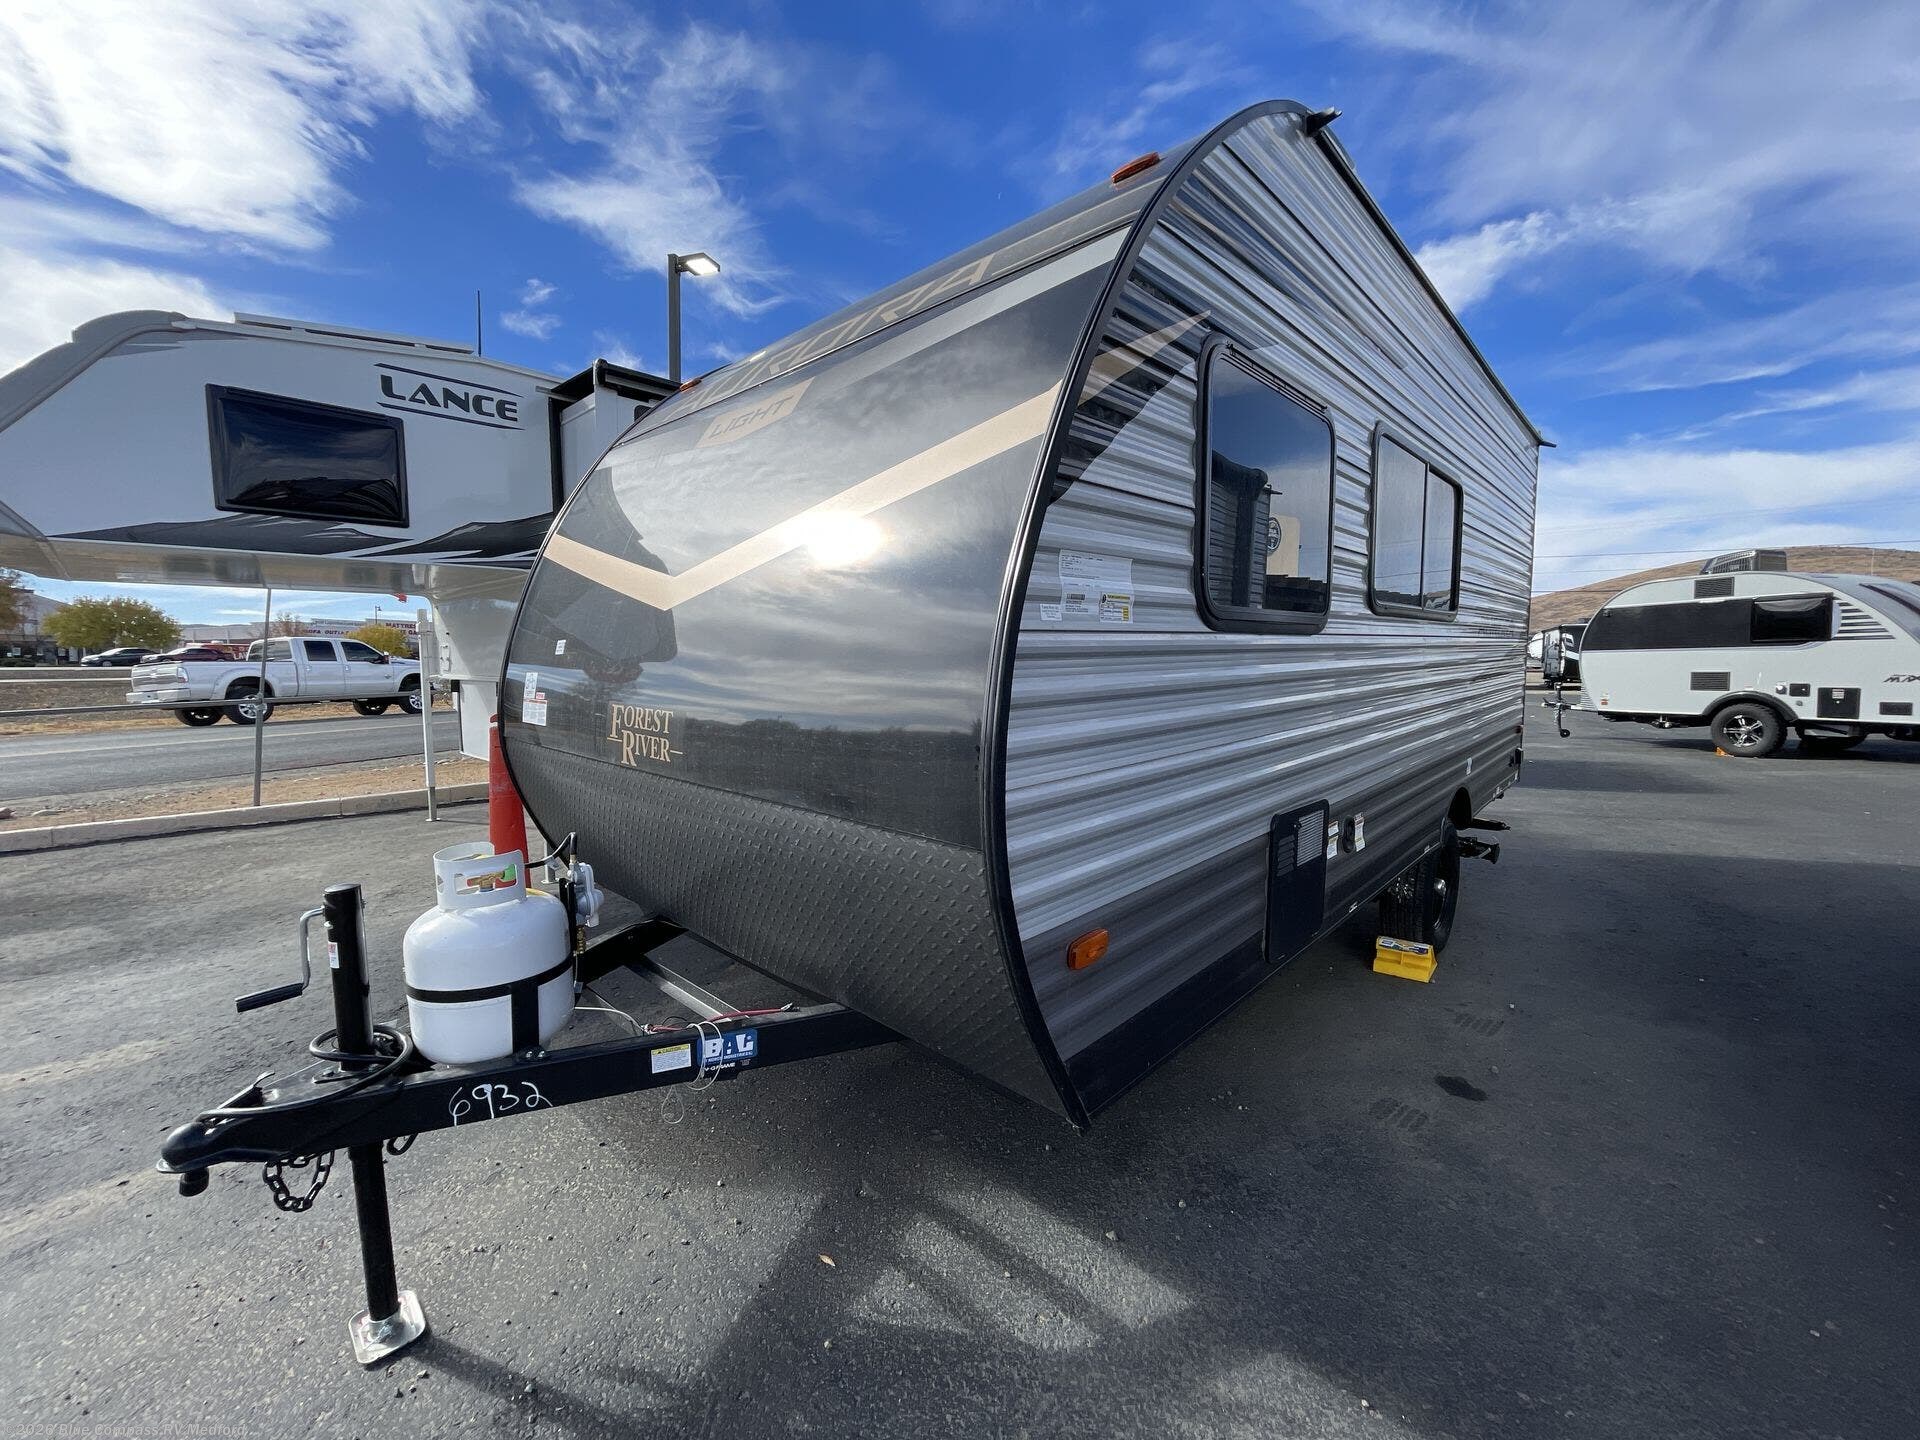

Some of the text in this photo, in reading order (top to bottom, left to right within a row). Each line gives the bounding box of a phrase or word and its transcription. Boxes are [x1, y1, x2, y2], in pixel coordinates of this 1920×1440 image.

[380, 374, 519, 422] LANCE
[708, 394, 795, 439] LIGHT
[609, 703, 674, 739] FOREST
[620, 729, 671, 767] RIVER
[703, 1033, 755, 1059] BAL
[448, 1081, 554, 1127] 6932
